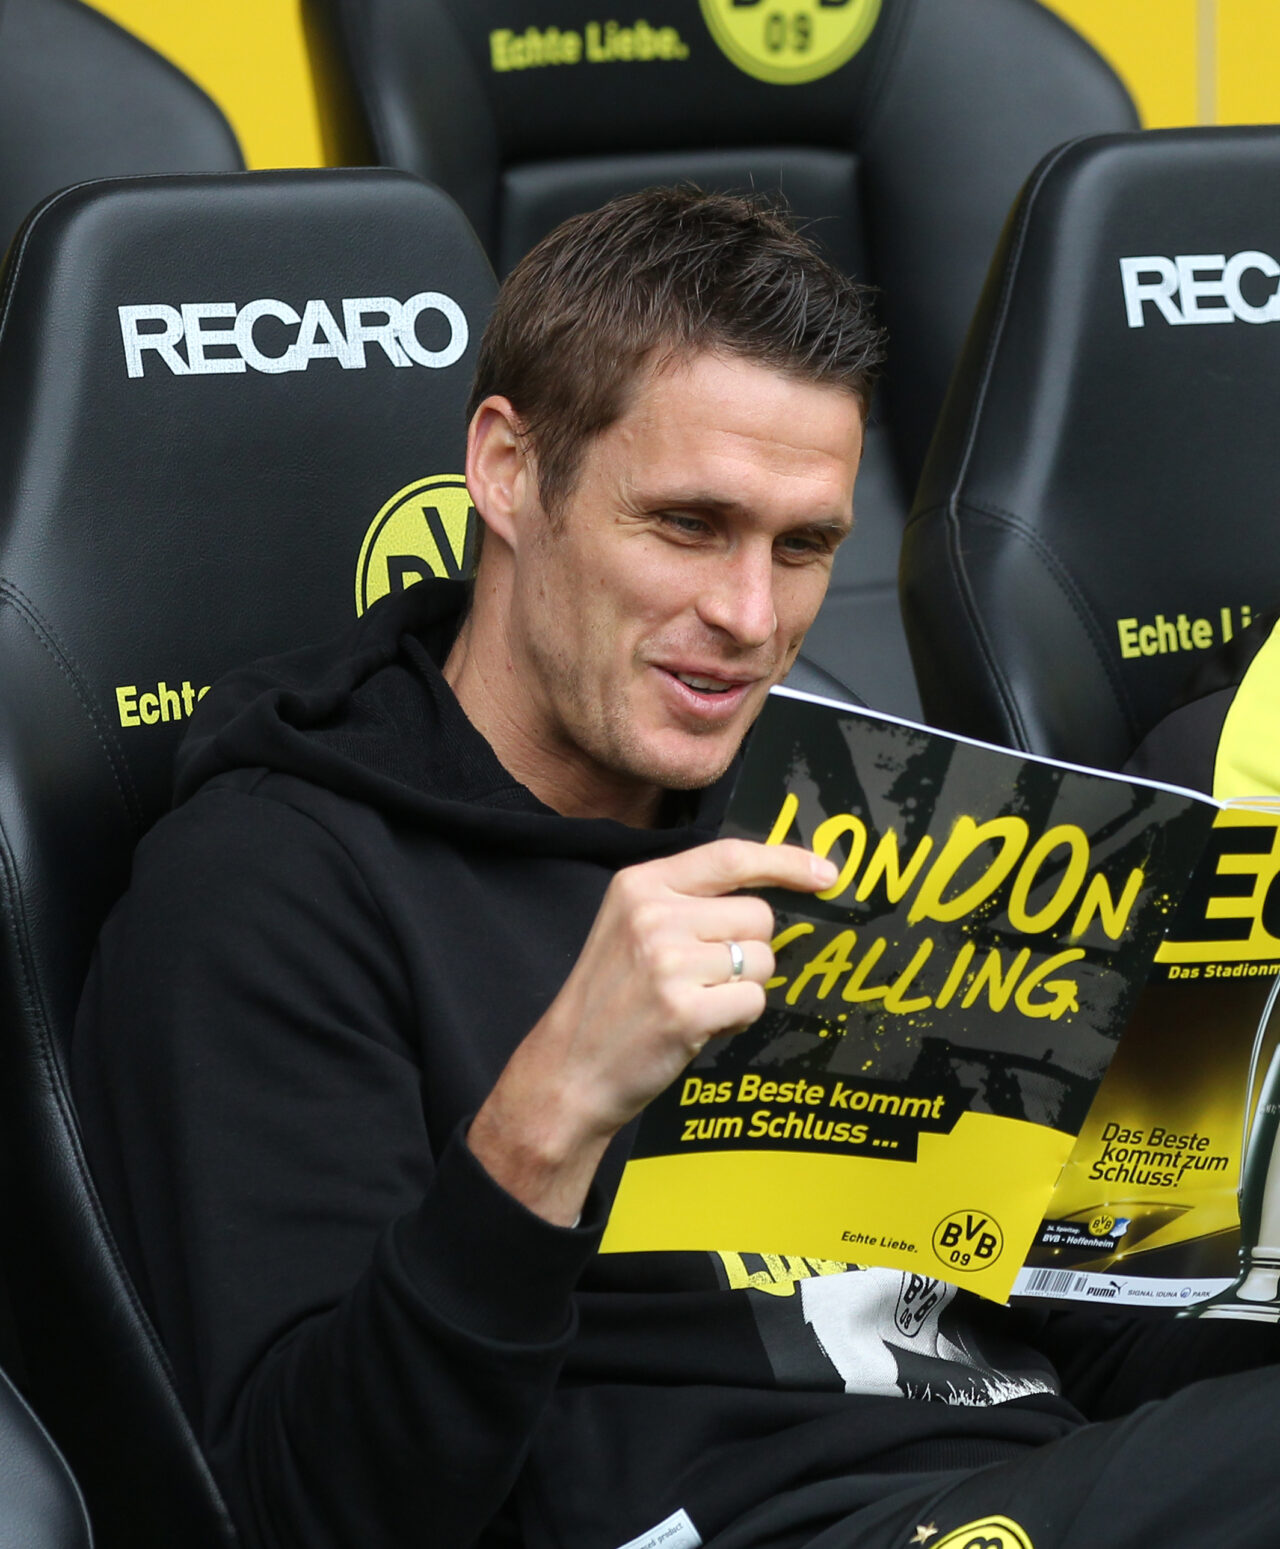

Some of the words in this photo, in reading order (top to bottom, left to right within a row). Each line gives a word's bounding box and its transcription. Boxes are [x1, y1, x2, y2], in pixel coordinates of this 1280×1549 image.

[490, 26, 582, 72] Echte
[585, 20, 690, 63] Liebe.
[117, 291, 469, 379] RECARO
[1117, 612, 1214, 659] Echte
[115, 681, 212, 728] Echt
[1168, 965, 1199, 980] Das
[679, 1077, 733, 1107] Das
[737, 1074, 825, 1106] Beste
[829, 1082, 945, 1119] kommt
[681, 1116, 744, 1142] zum
[746, 1109, 870, 1145] Schluss
[1101, 1122, 1144, 1145] Das
[1146, 1127, 1210, 1152] Beste
[1100, 1141, 1182, 1168] kommt
[1181, 1155, 1230, 1171] zum
[1088, 1161, 1185, 1188] Schluss!
[841, 1231, 878, 1246] Echte
[879, 1237, 918, 1253] Liebe.
[939, 1214, 998, 1260] BVB
[1042, 1233, 1061, 1243] BVB
[1066, 1236, 1115, 1249] Hoffenheim
[949, 1250, 971, 1266] 09
[1086, 1286, 1117, 1298] PUMA
[1156, 1290, 1178, 1298] IDUNA
[1192, 1290, 1211, 1298] PARK
